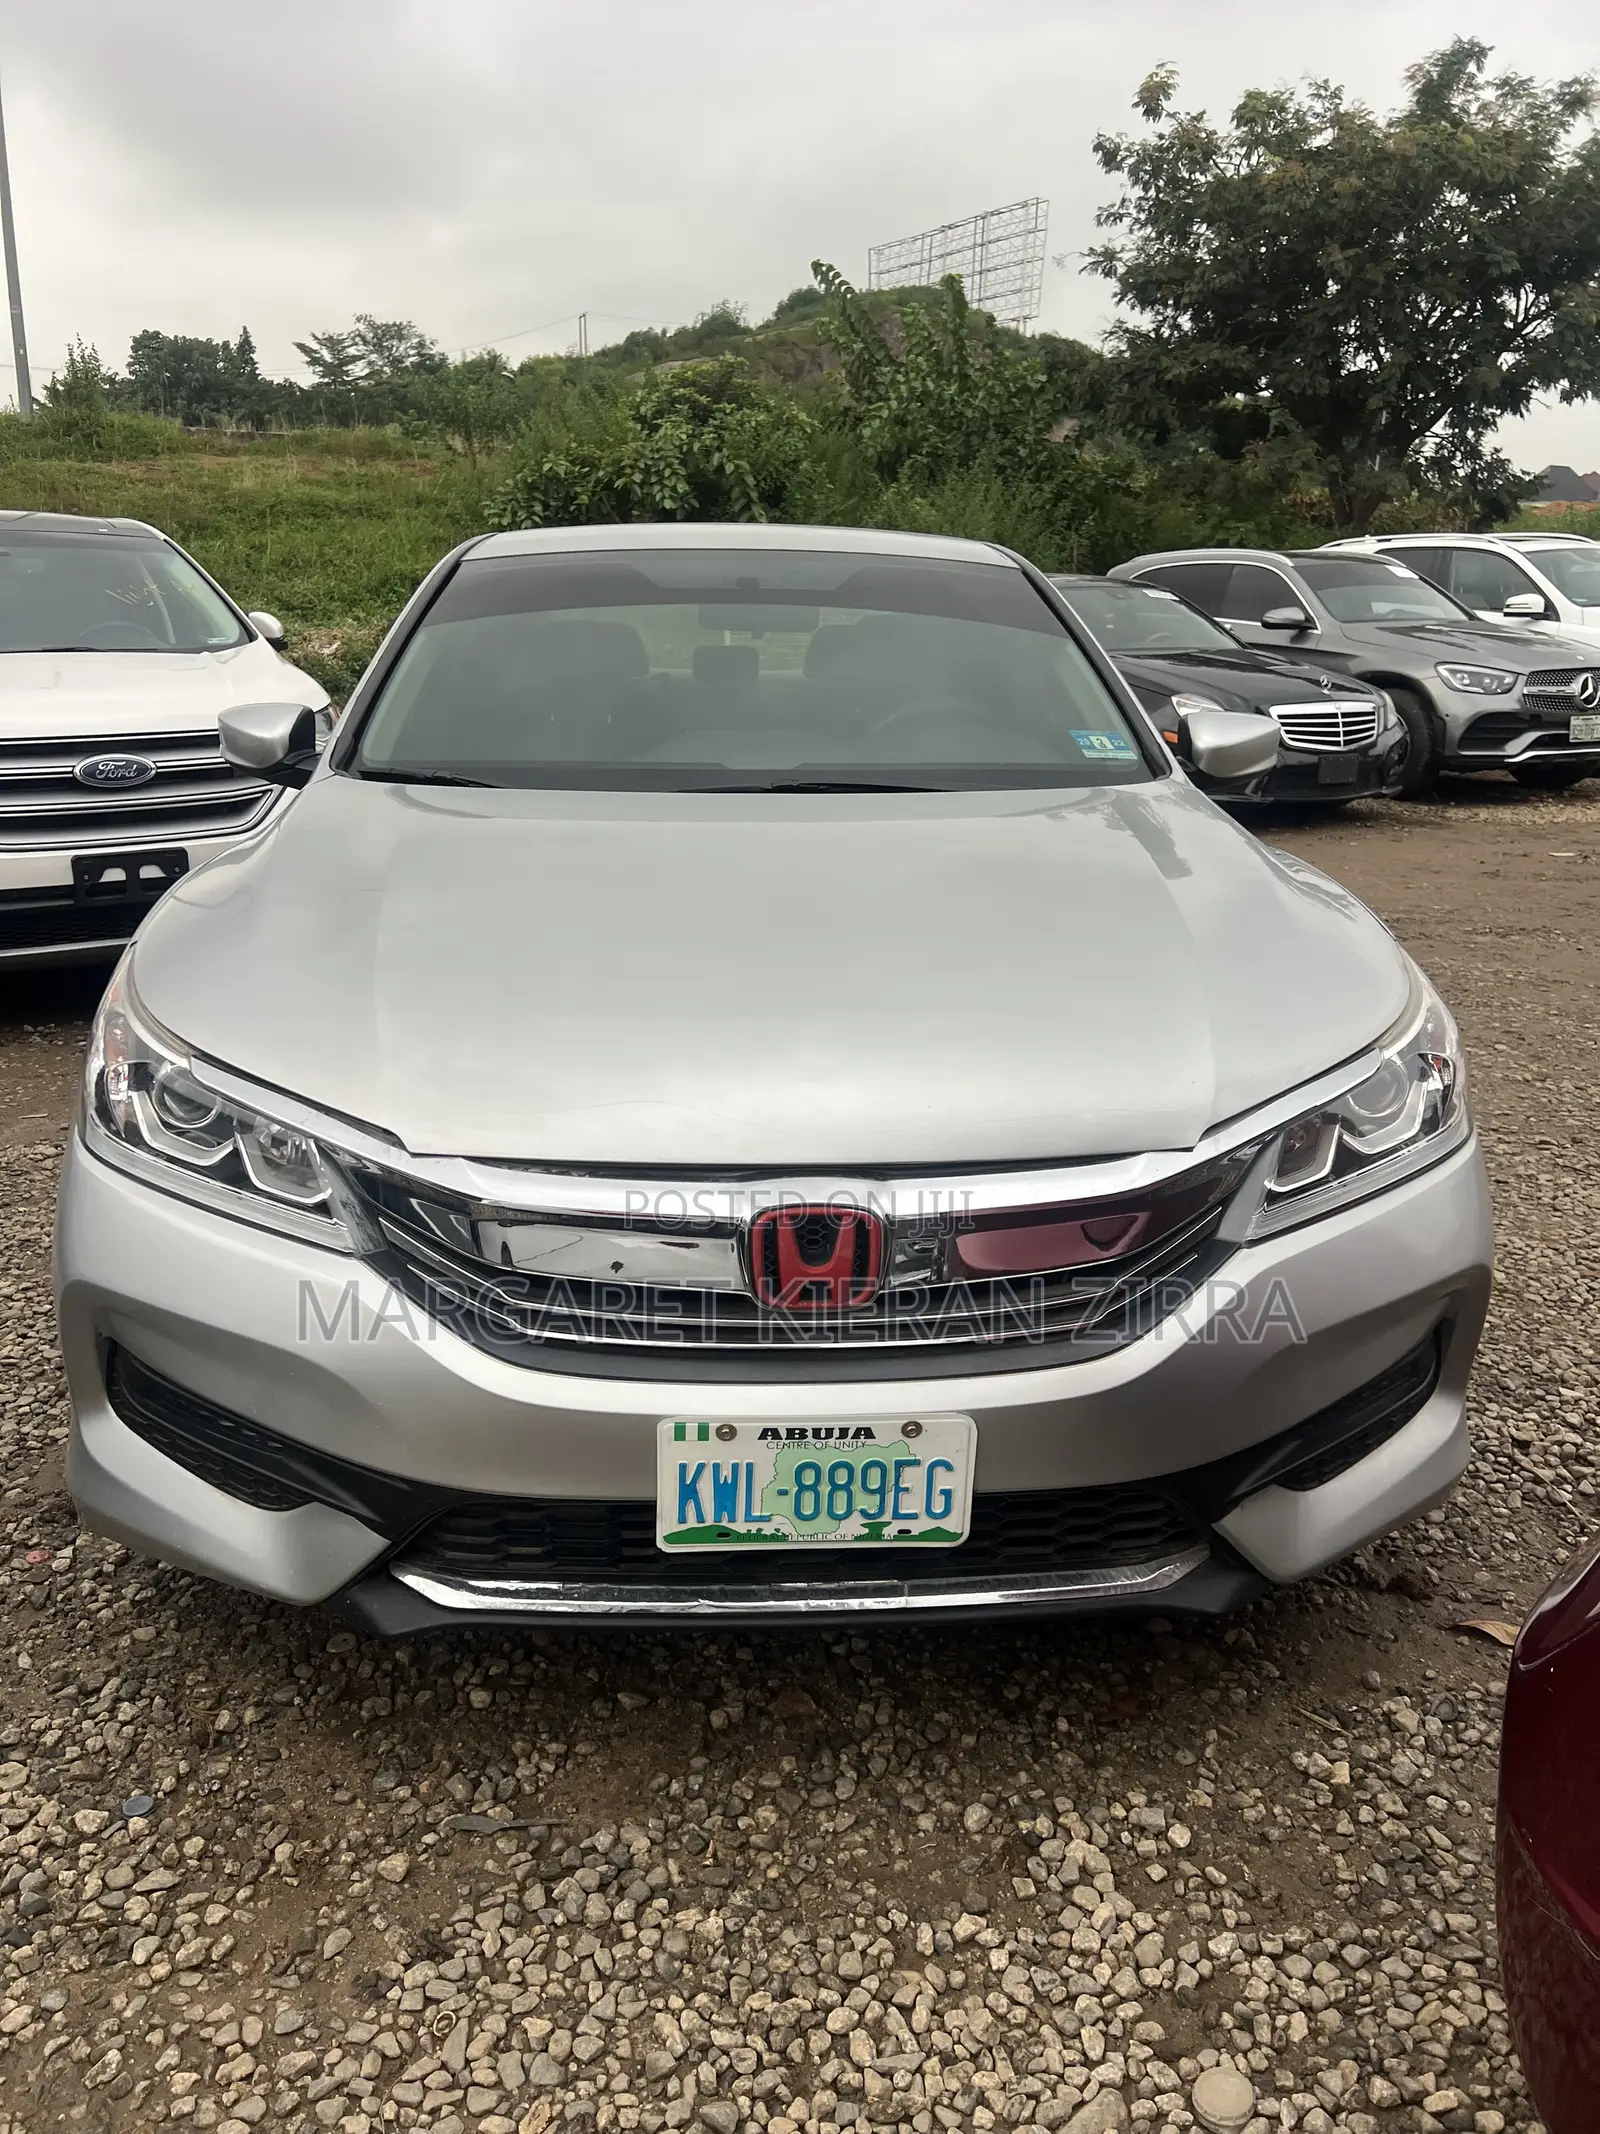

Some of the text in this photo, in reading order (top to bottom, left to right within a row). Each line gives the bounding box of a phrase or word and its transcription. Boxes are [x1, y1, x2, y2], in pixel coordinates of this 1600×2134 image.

[95, 760, 138, 779] Ford
[757, 1426, 877, 1441] ABUJA
[766, 1439, 867, 1451] CENTRE OF UNITY
[677, 1458, 954, 1524] KWL-889EG
[834, 1532, 850, 1541] OF
